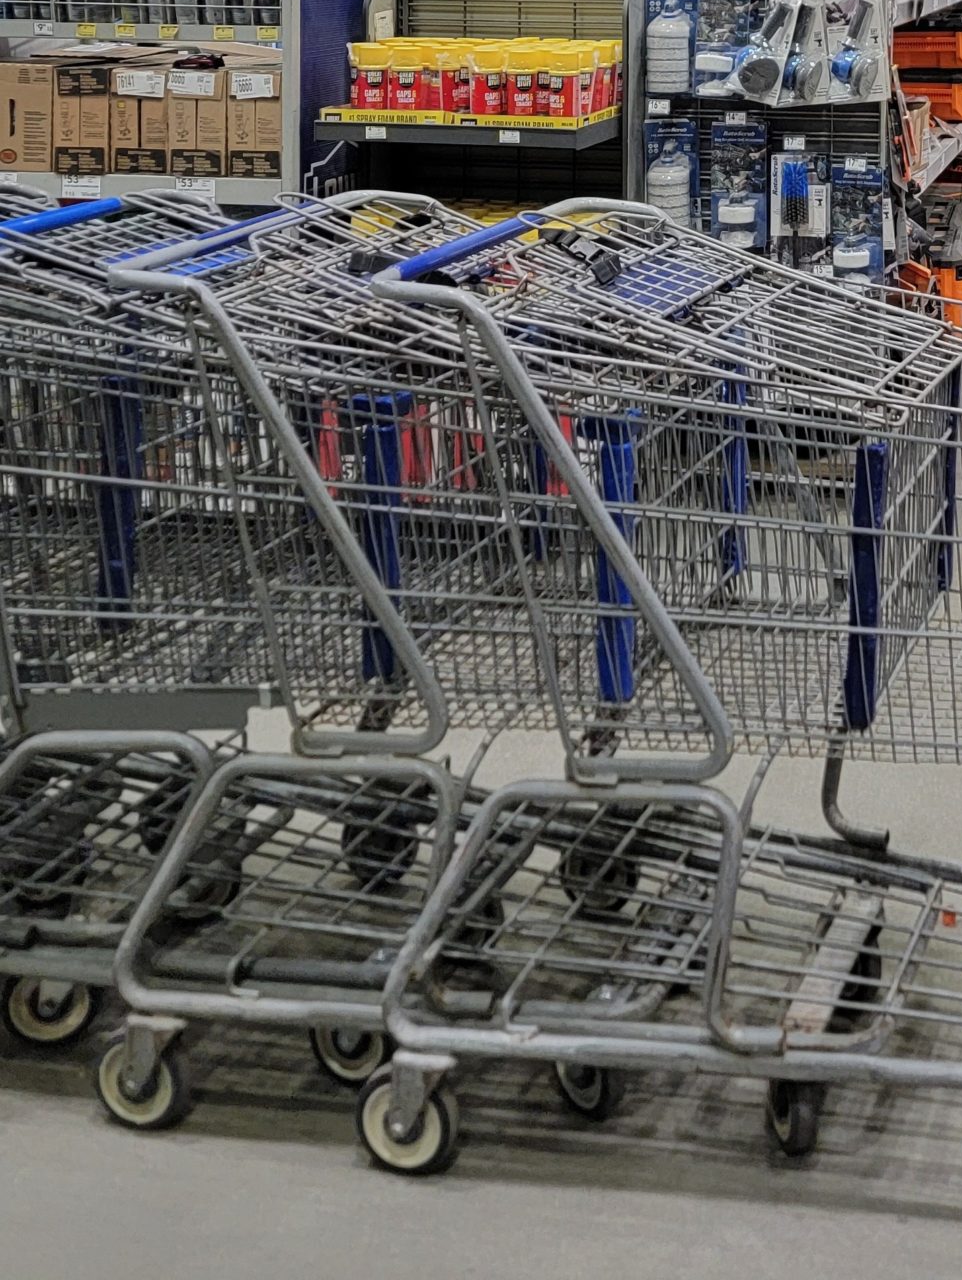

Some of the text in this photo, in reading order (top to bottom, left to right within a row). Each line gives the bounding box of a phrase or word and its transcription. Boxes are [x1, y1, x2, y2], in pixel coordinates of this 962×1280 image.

[356, 114, 376, 123] SPRAY
[377, 115, 394, 123] FOAM
[397, 115, 417, 123] BRAND
